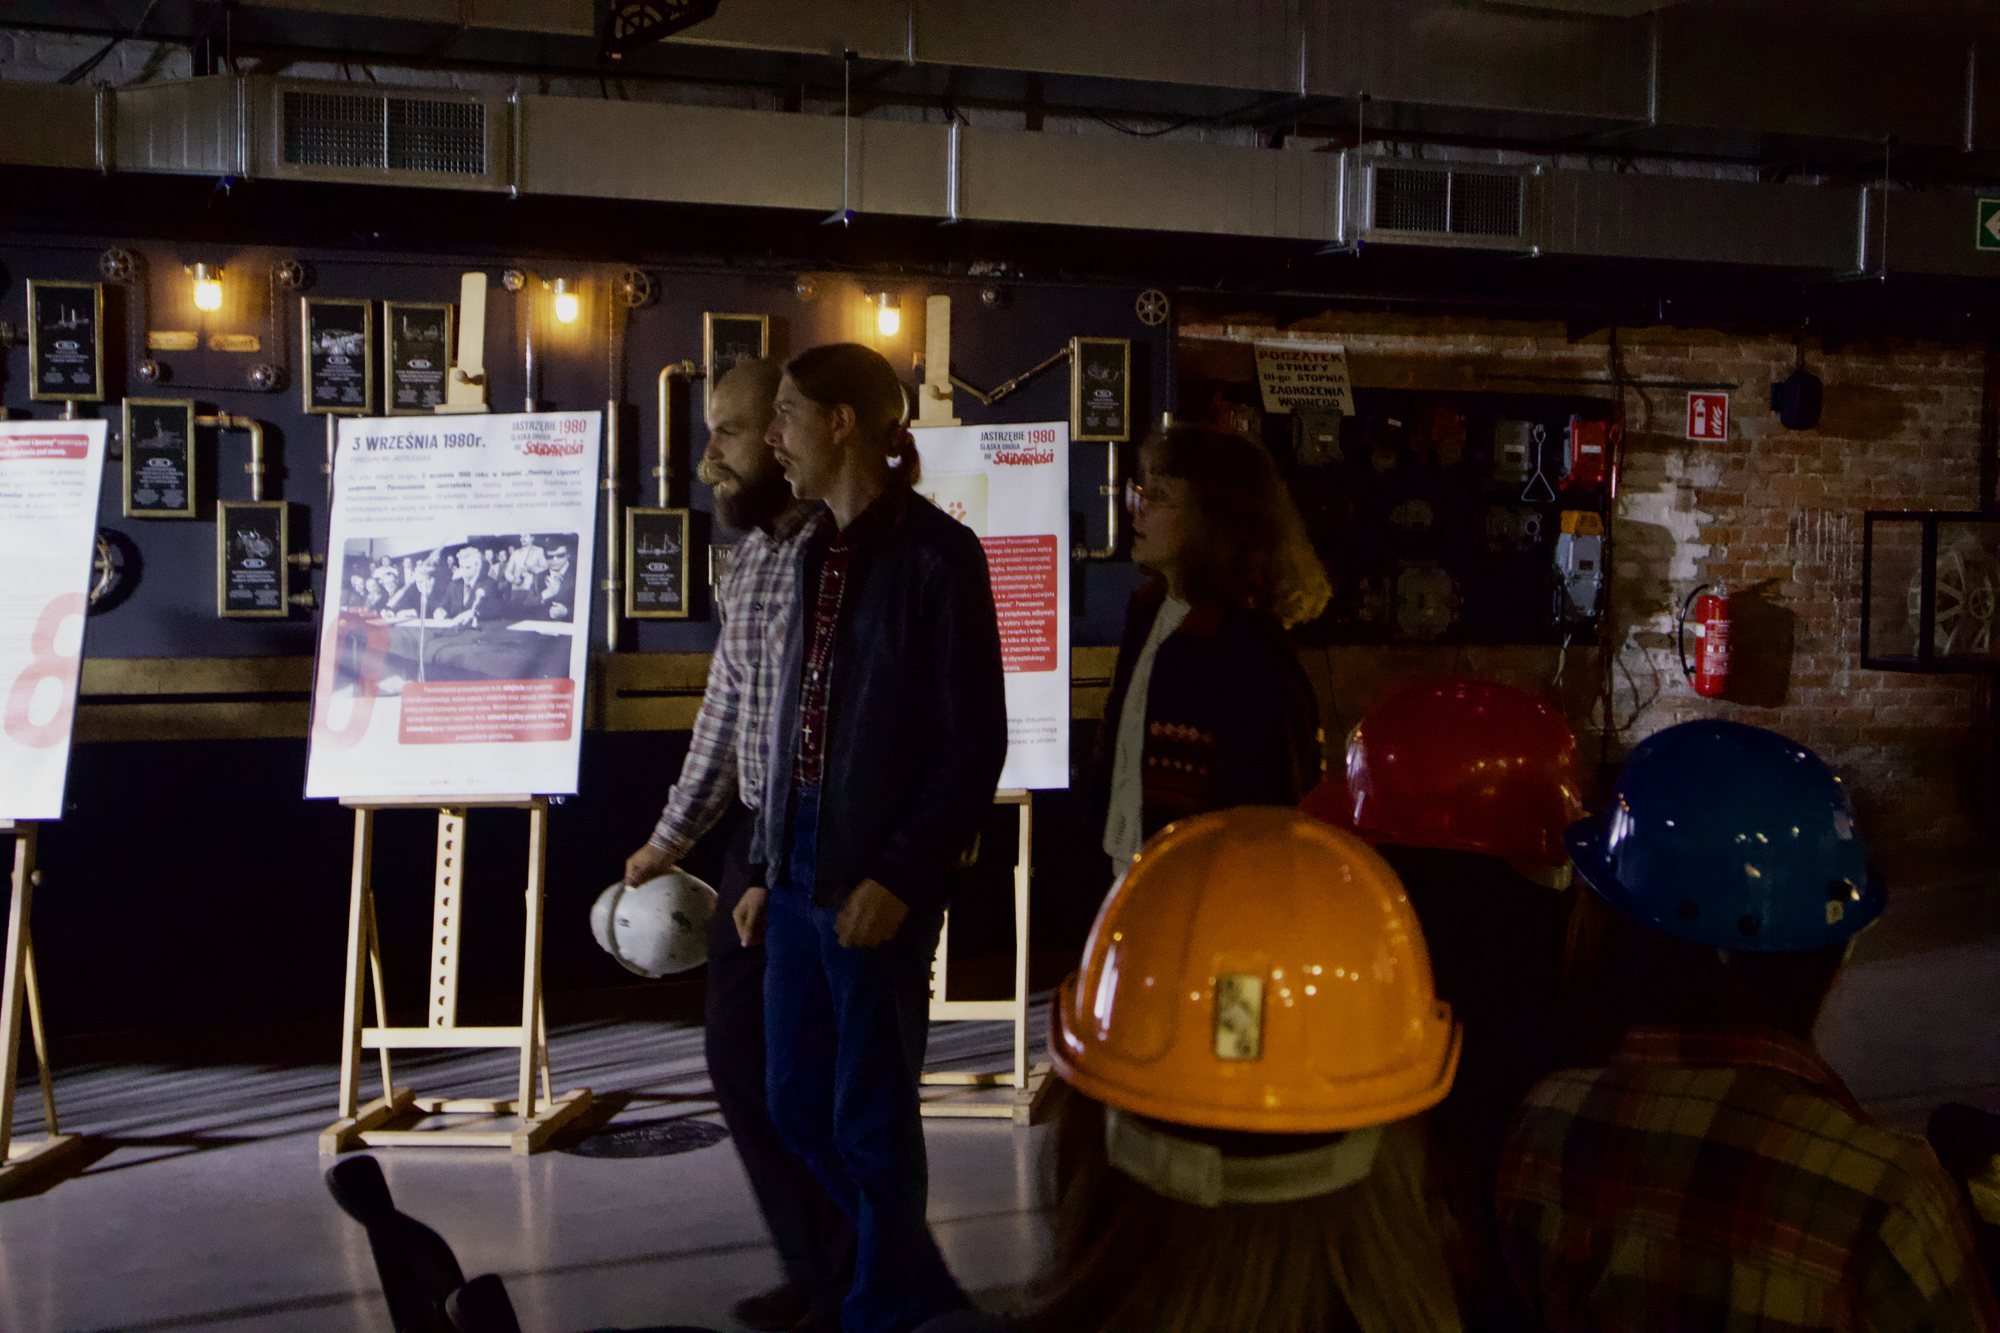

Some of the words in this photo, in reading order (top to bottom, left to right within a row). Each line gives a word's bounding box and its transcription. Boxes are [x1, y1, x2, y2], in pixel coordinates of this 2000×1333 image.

[1297, 373, 1345, 382] STOPNIA
[559, 419, 587, 434] 1980
[352, 436, 361, 451] 3
[365, 431, 439, 451] WRZEŚNIA
[443, 432, 486, 449] 1980r.
[980, 431, 1025, 442] JASTRZĘBIE
[1027, 429, 1055, 444] 1980
